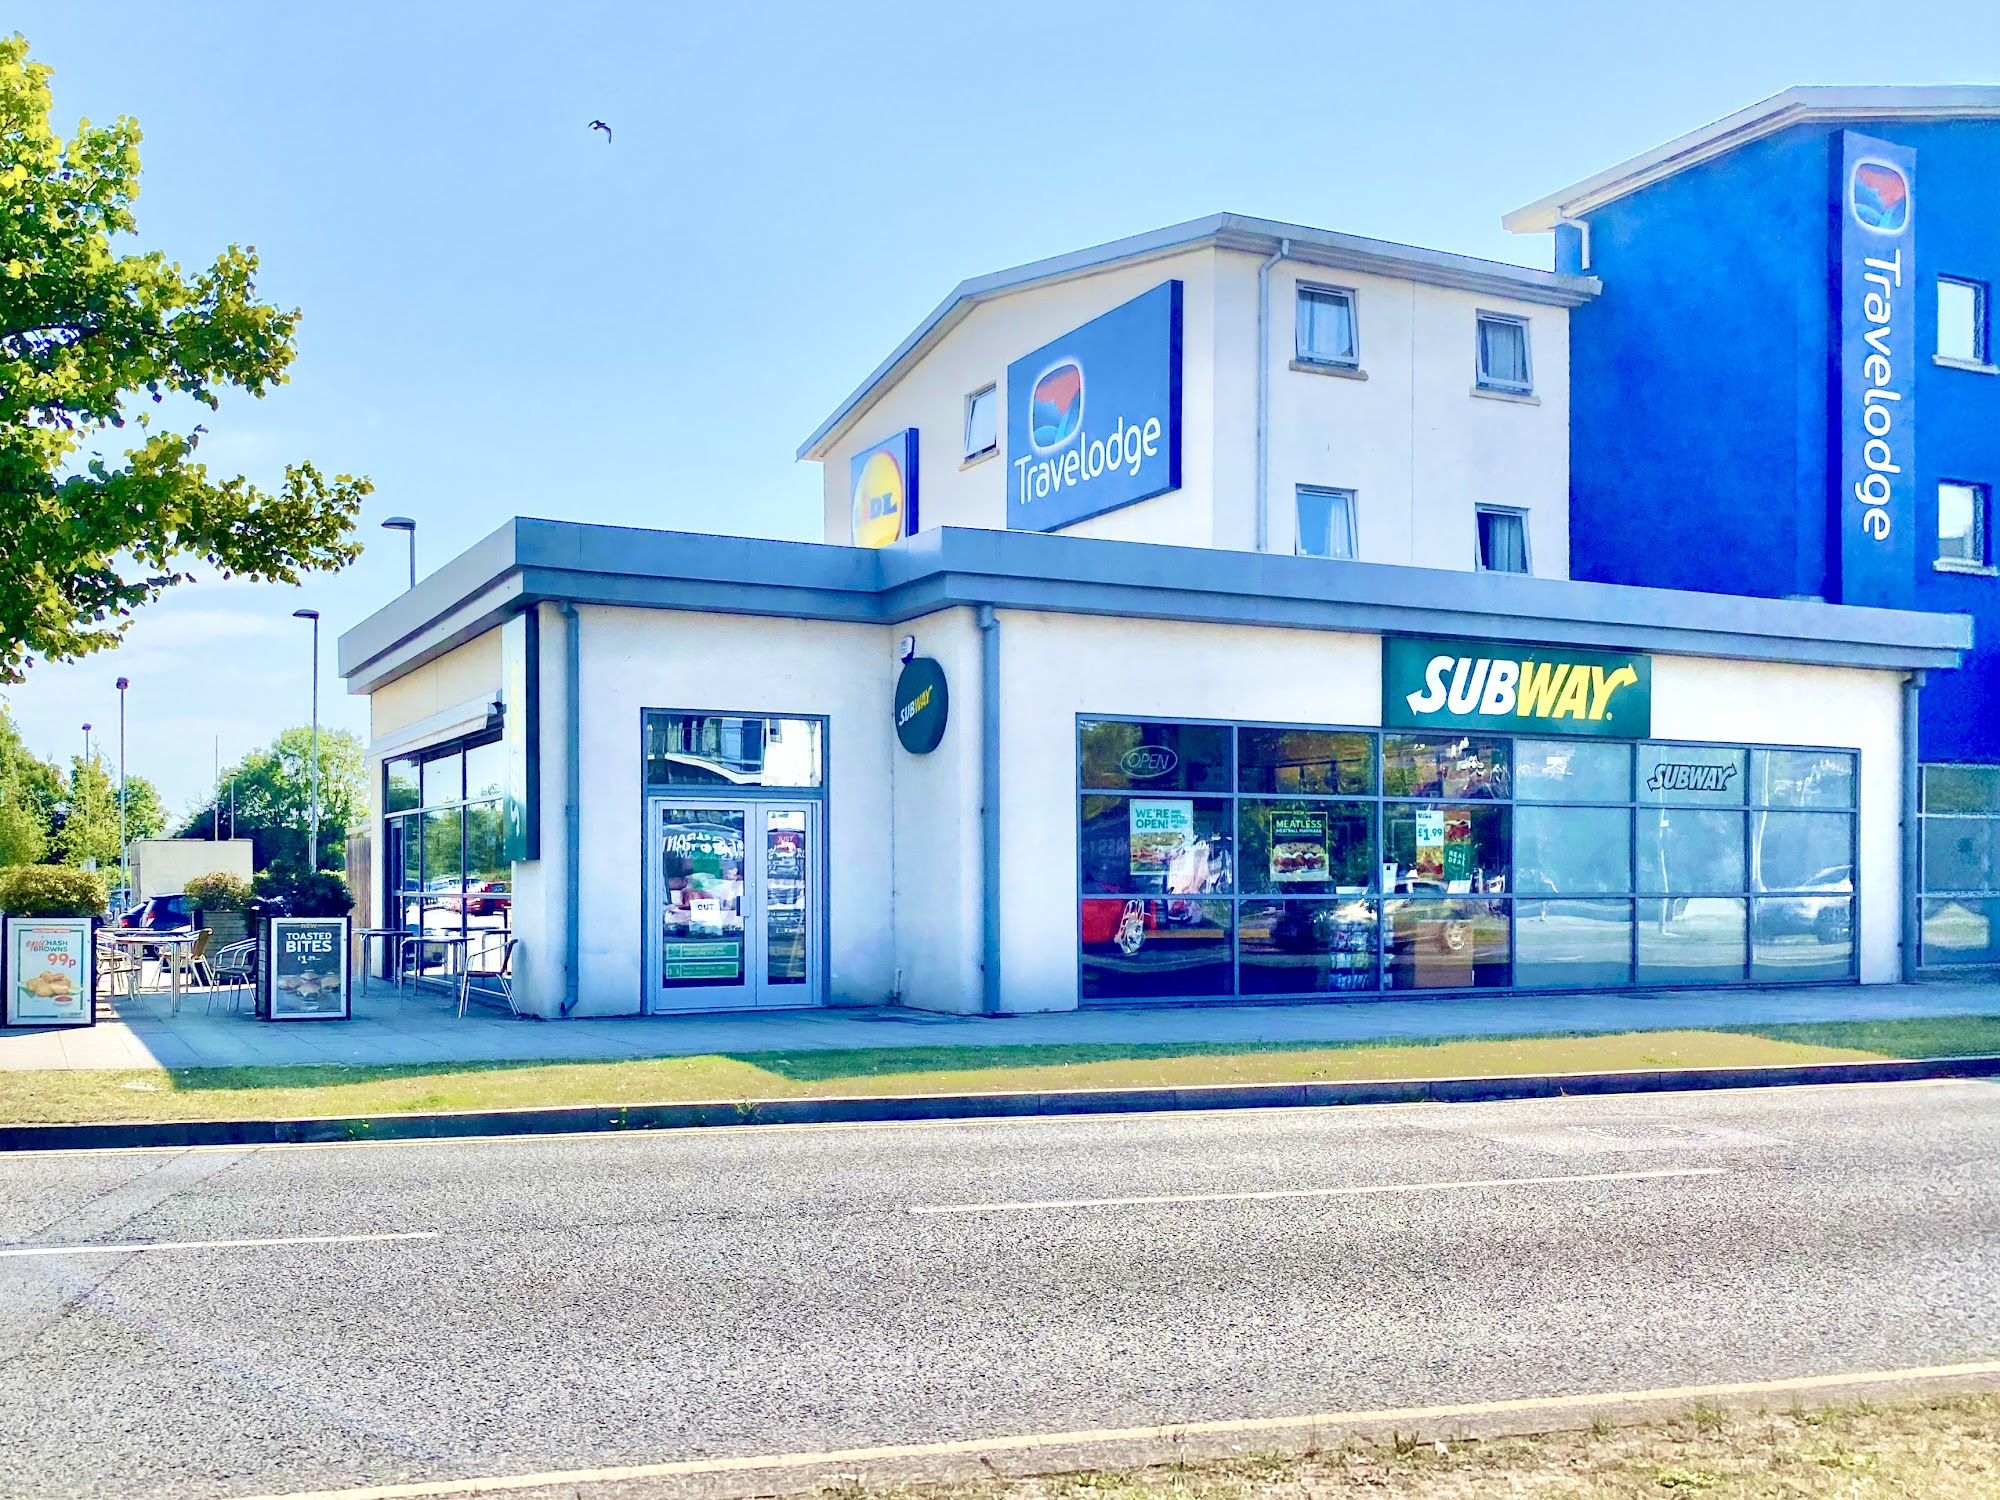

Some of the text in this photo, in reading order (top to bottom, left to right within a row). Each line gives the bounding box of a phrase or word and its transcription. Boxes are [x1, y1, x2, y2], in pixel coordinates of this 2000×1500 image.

[1855, 248, 1901, 542] Travelodge
[1014, 416, 1161, 505] Travelodge
[1405, 655, 1638, 721] SUBWAY
[898, 684, 933, 727] SUBWAY
[1128, 752, 1170, 770] OPEN
[1647, 762, 1738, 793] SUBWAY
[1135, 808, 1170, 819] WE'RE
[1136, 818, 1169, 829] OPEN!
[1275, 819, 1323, 829] MEATLESS
[1418, 828, 1443, 841] £1.99
[1447, 857, 1465, 867] DEAL
[1449, 850, 1466, 862] REAL
[697, 903, 714, 911] OUT
[285, 932, 333, 940] TOASTED
[285, 940, 333, 953] BITES
[47, 953, 77, 968] 99p
